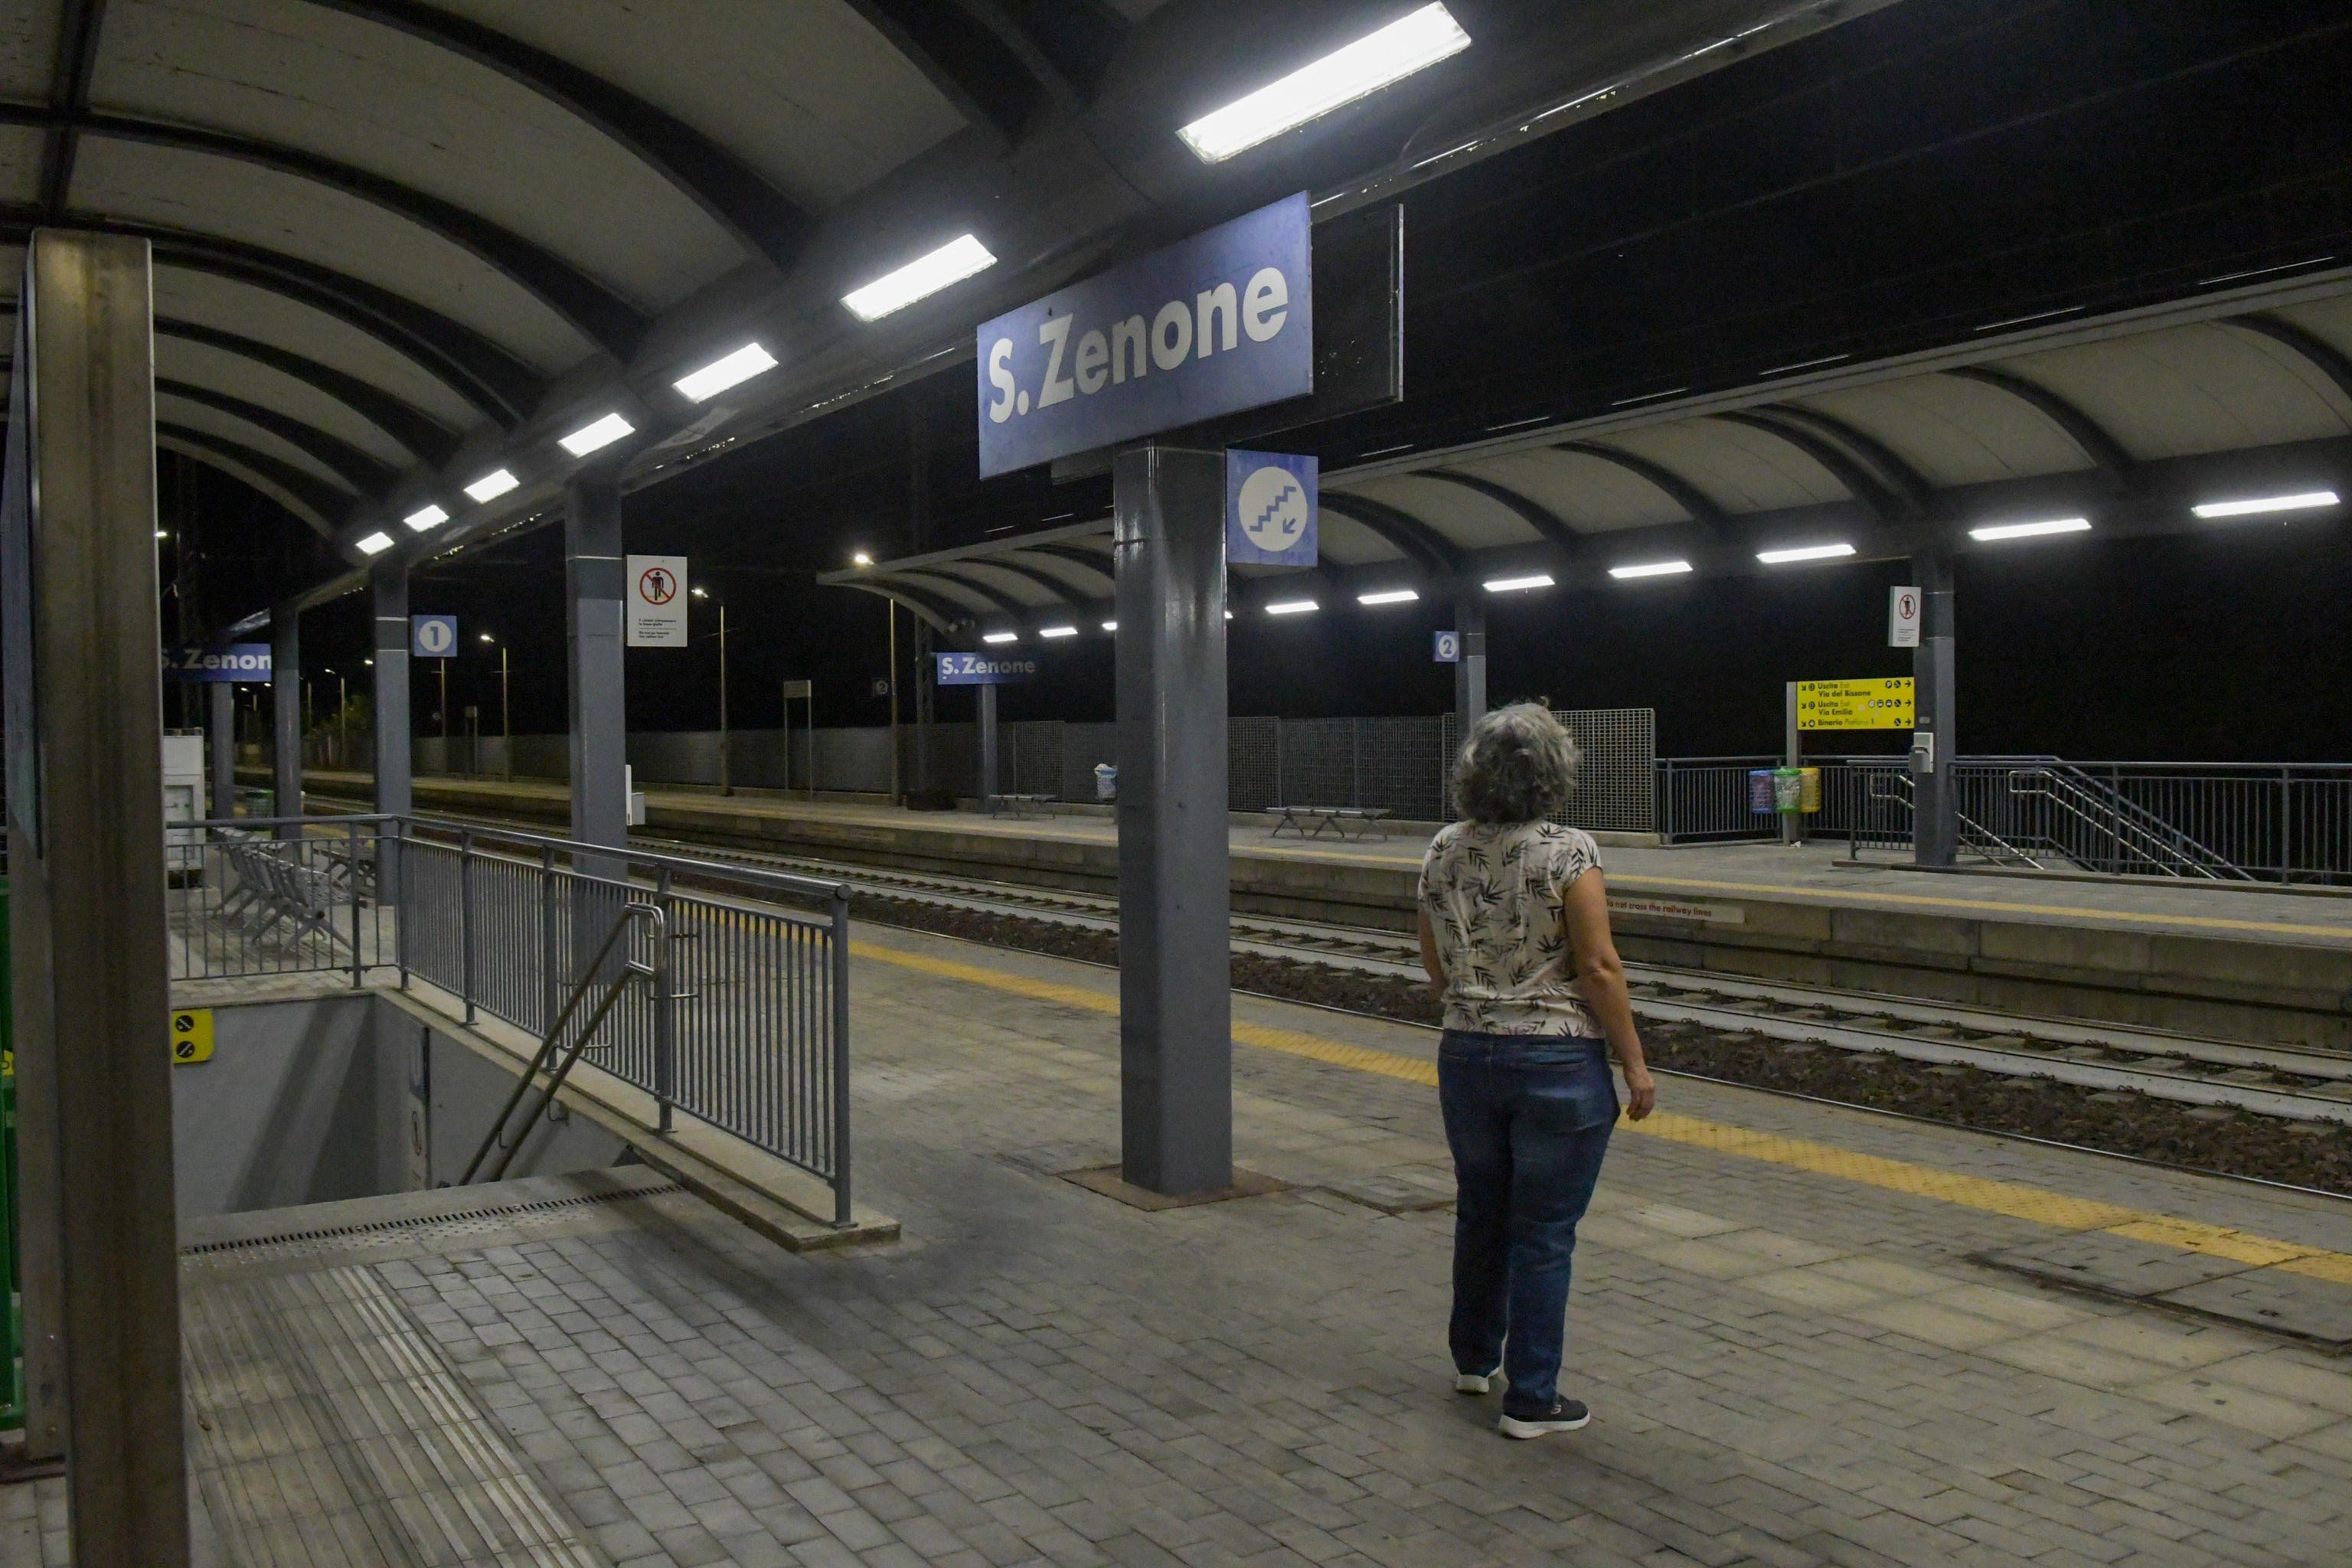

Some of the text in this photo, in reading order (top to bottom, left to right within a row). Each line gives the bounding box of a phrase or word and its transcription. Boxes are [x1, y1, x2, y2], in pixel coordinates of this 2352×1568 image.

[989, 266, 1288, 423] S. Zenone
[430, 626, 438, 646] 1
[1443, 639, 1452, 654] 2
[942, 656, 1036, 675] S. Zenone
[1649, 903, 1661, 912] the
[1663, 905, 1691, 916] railway
[1694, 906, 1711, 916] lines
